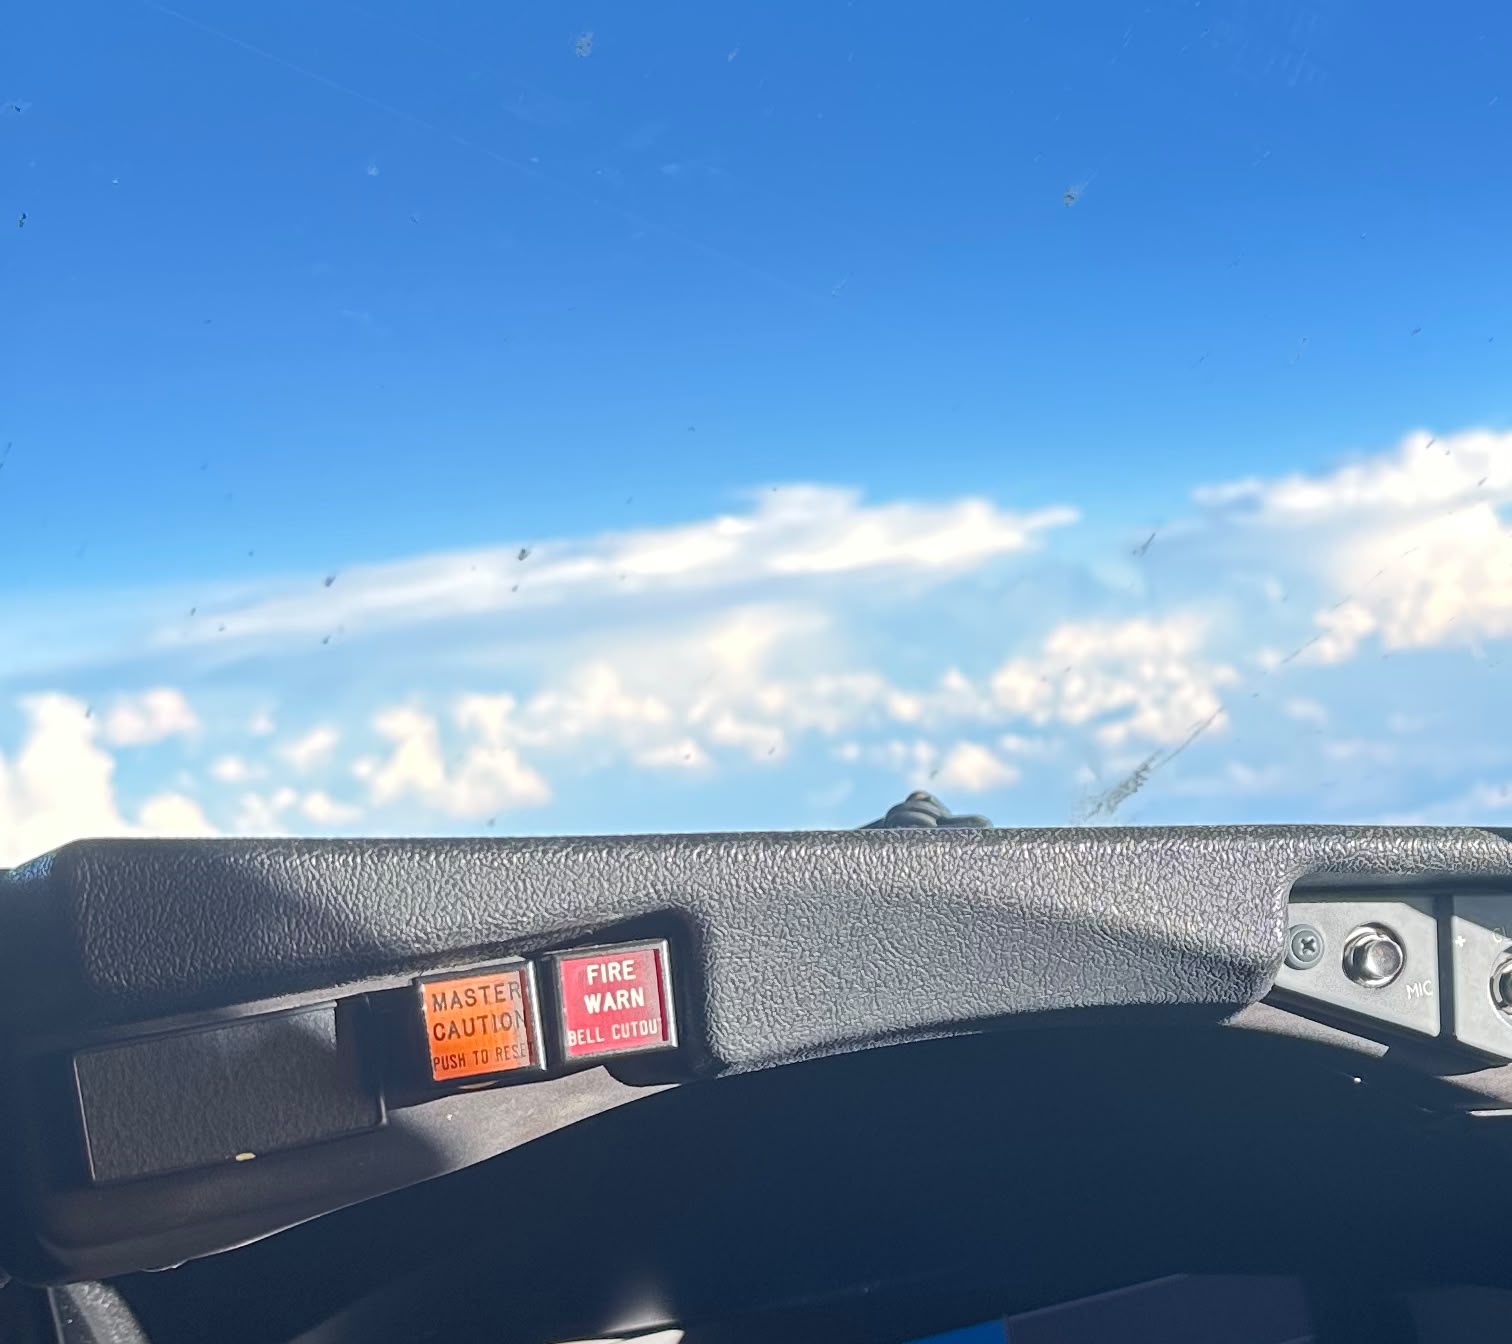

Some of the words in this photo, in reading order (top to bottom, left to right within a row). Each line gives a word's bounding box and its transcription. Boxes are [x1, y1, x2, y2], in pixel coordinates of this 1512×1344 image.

[587, 959, 637, 985] FIRE
[431, 981, 522, 1012] MASTER
[584, 987, 645, 1015] WARN
[1406, 981, 1434, 1001] MIC
[434, 1011, 525, 1042] CAUTION
[567, 1029, 604, 1047] BELL
[434, 1052, 466, 1071] PUSH
[473, 1049, 490, 1066] TO
